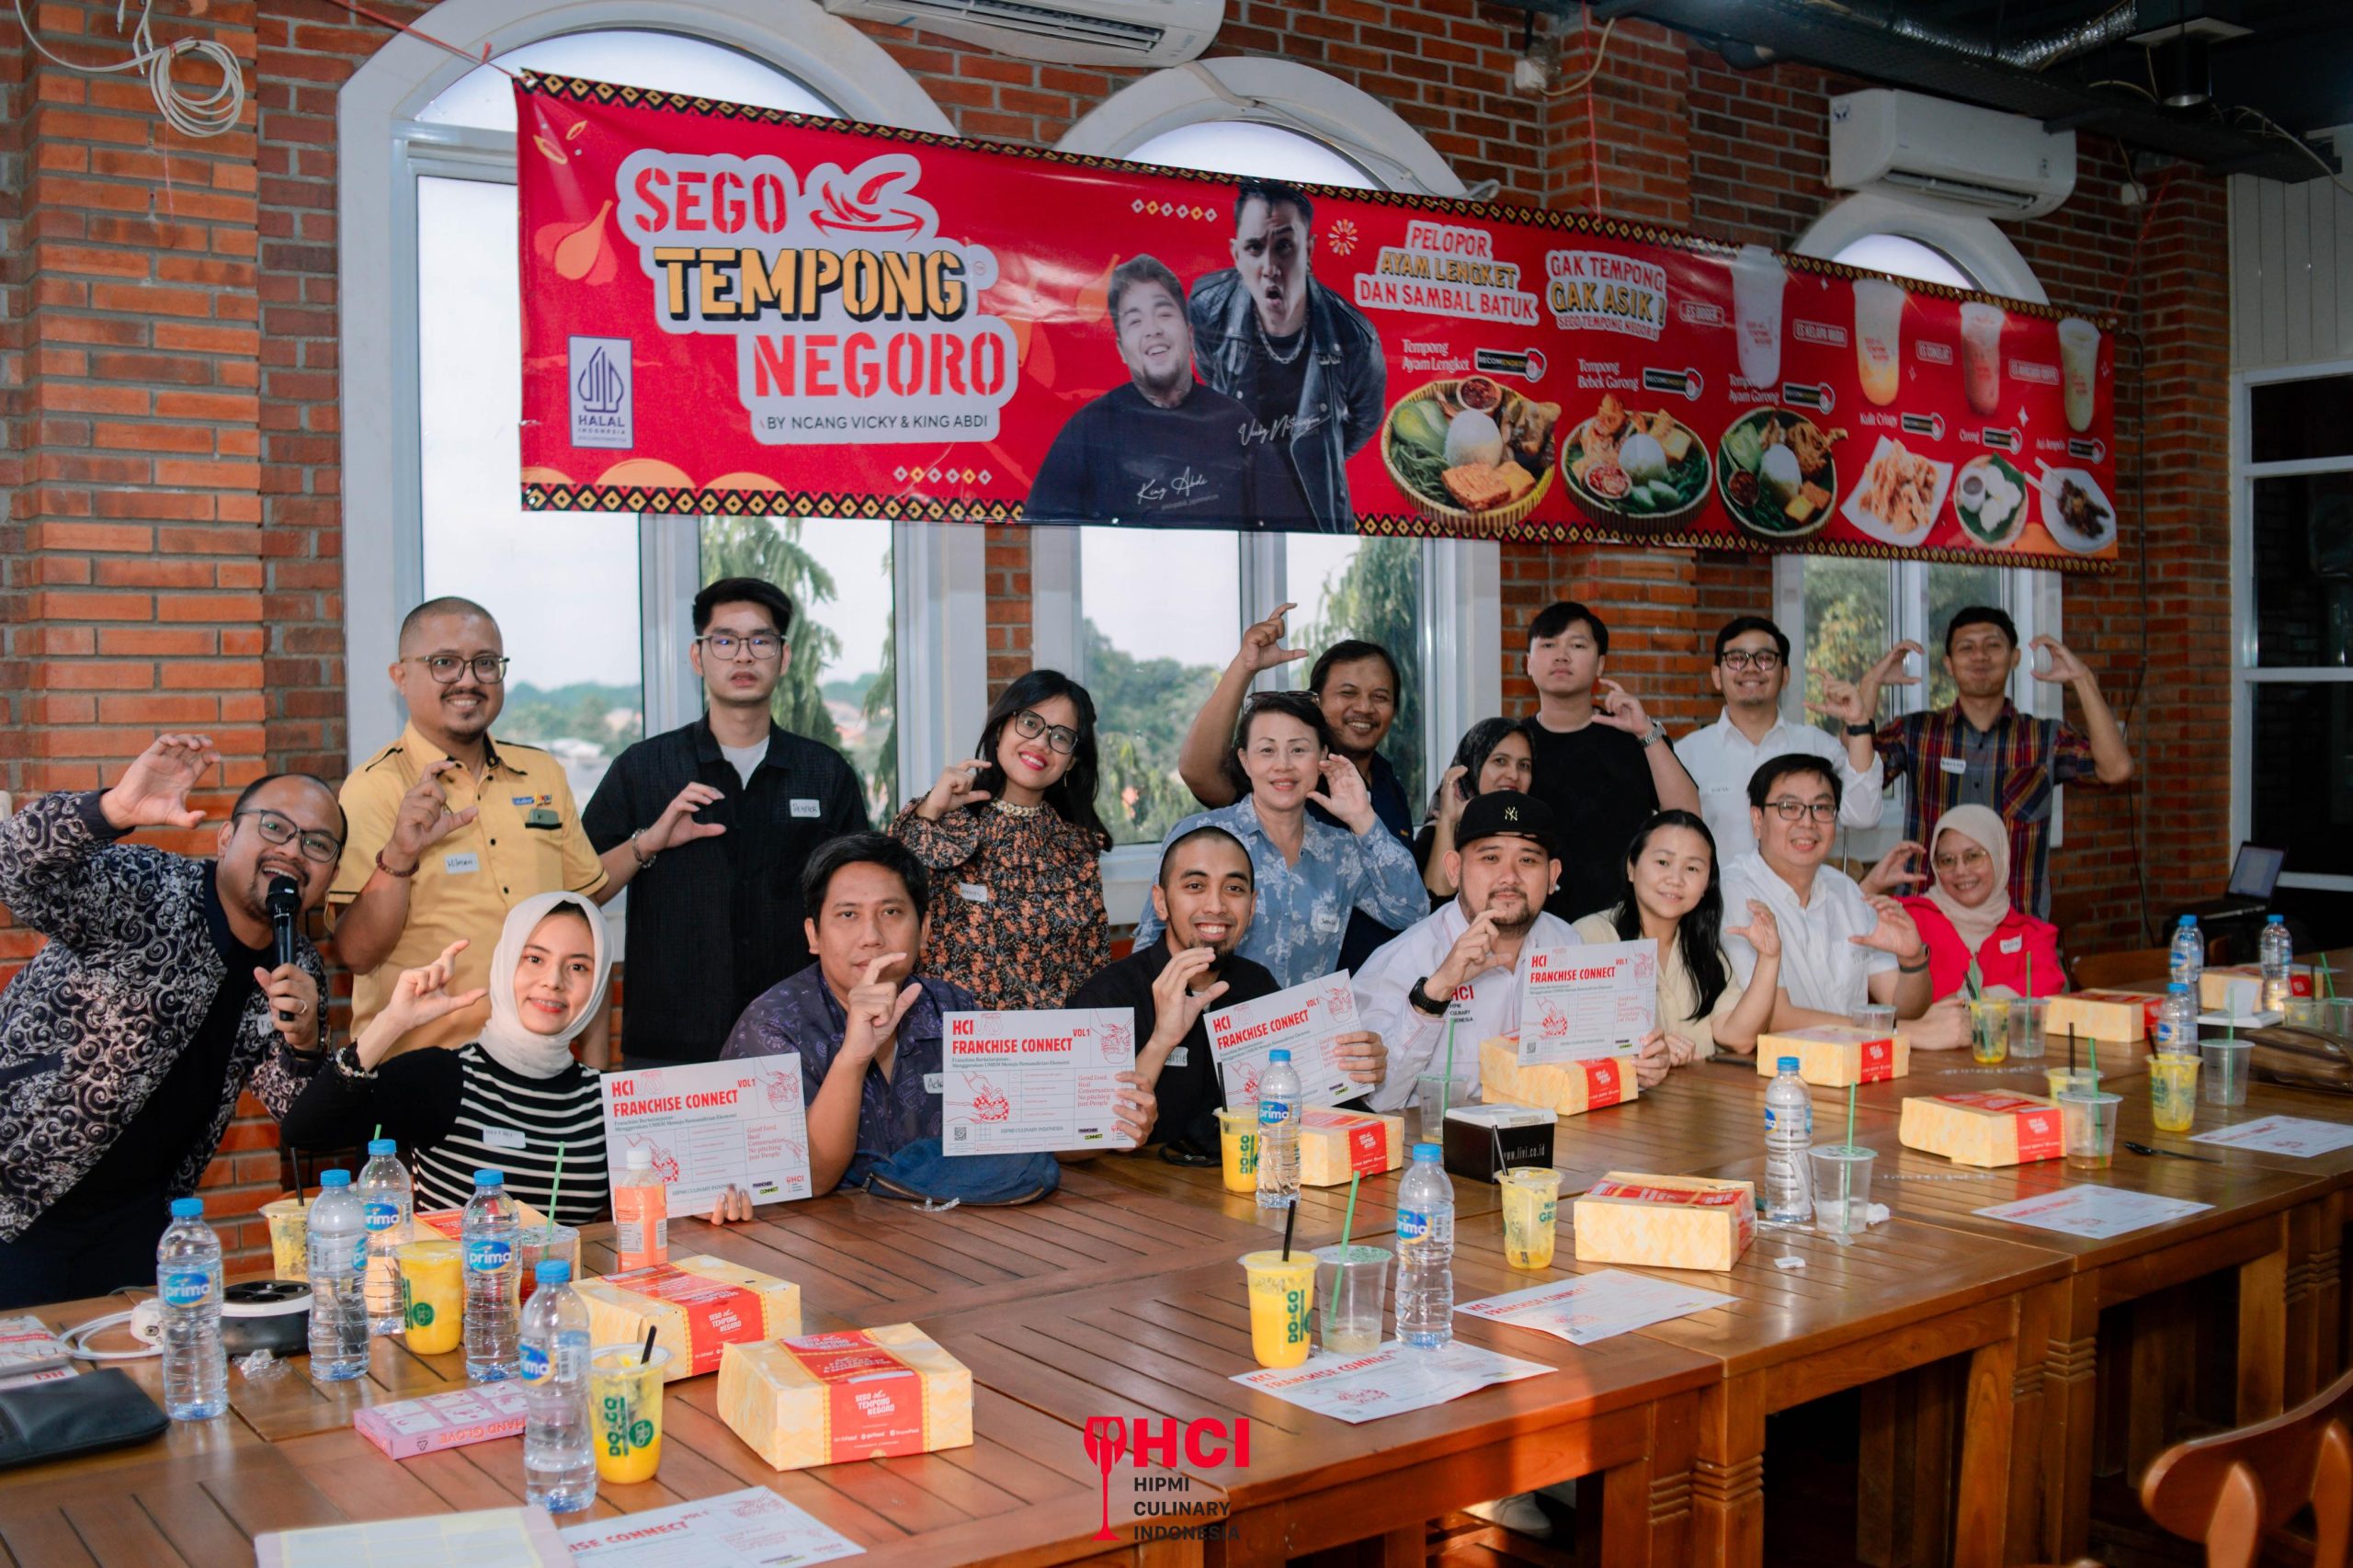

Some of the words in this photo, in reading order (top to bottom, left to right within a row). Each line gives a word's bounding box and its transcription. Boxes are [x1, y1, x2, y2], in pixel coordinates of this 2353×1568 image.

[634, 167, 788, 233] SEGO
[1410, 226, 1488, 258] PELOPOR
[1380, 250, 1432, 278] AYAM
[1435, 256, 1517, 291] LENGKET
[1551, 255, 1584, 277] GAK
[1589, 256, 1664, 293] TEMPONG
[654, 246, 967, 323] TEMPONG
[1359, 279, 1397, 306] DAN
[1402, 283, 1475, 314] SAMBAL
[1480, 291, 1534, 321] BATUK
[1551, 281, 1599, 313] GAK
[1602, 284, 1654, 323] ASIK
[1402, 338, 1449, 357] Tempong
[754, 331, 1006, 399] NEGORO
[1402, 356, 1431, 373] Ayam
[1432, 357, 1471, 373] Lengket
[1577, 358, 1620, 375] Tempong
[578, 415, 625, 427] HALAL
[767, 416, 786, 429] BY
[791, 416, 847, 429] NCANG
[851, 415, 897, 428] VICKY
[901, 415, 909, 428] &
[913, 415, 950, 428] KING
[953, 415, 987, 427] ABDI
[1531, 954, 1547, 968] HCI
[1530, 970, 1577, 984] FRANCHISE
[1579, 966, 1616, 981] CONNECT
[952, 1019, 974, 1035] HCI
[1212, 1015, 1231, 1033] HCI
[1216, 1026, 1268, 1050] FRANCHISE
[1269, 1009, 1310, 1031] CONNECT
[951, 1039, 1017, 1054] FRANCHISE
[1021, 1037, 1073, 1052] CONNECT
[611, 1079, 634, 1098] HCI
[613, 1096, 682, 1118] FRANCHISE
[686, 1089, 739, 1110] CONNECT
[365, 1212, 400, 1225] rima
[858, 1397, 891, 1411] TEMPONG
[867, 1404, 895, 1416] NEGORO
[605, 1520, 689, 1544] CONNECT
